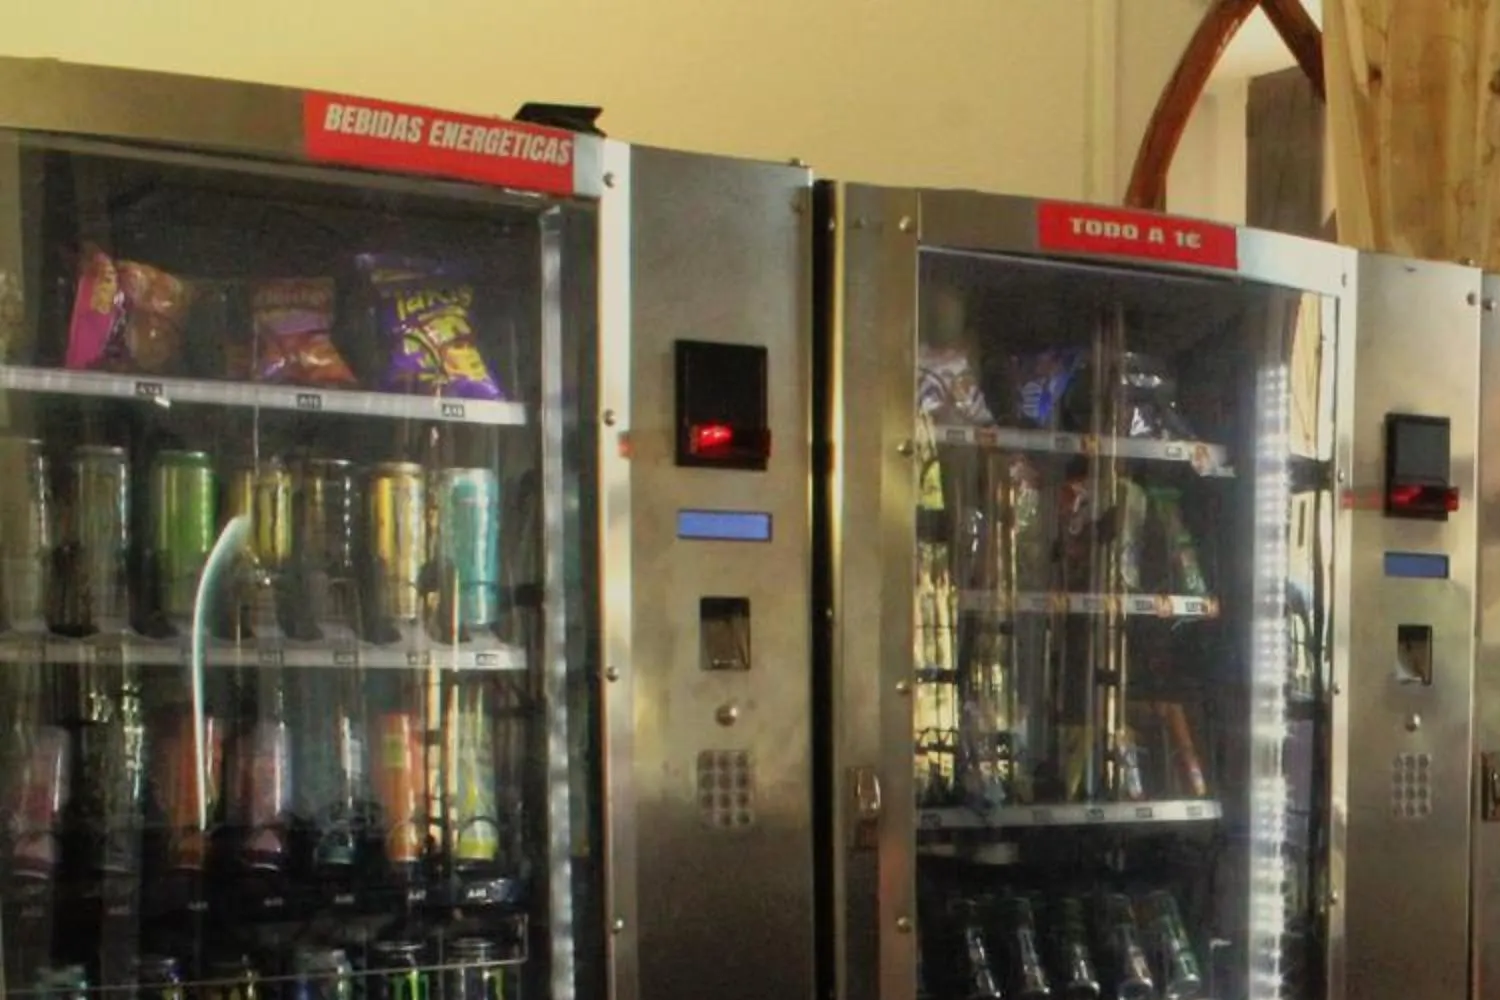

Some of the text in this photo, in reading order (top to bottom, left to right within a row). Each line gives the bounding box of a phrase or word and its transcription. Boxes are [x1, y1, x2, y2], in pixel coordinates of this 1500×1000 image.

[323, 102, 424, 145] BEBIDAS
[1070, 217, 1138, 240] TODO
[1147, 226, 1165, 244] A
